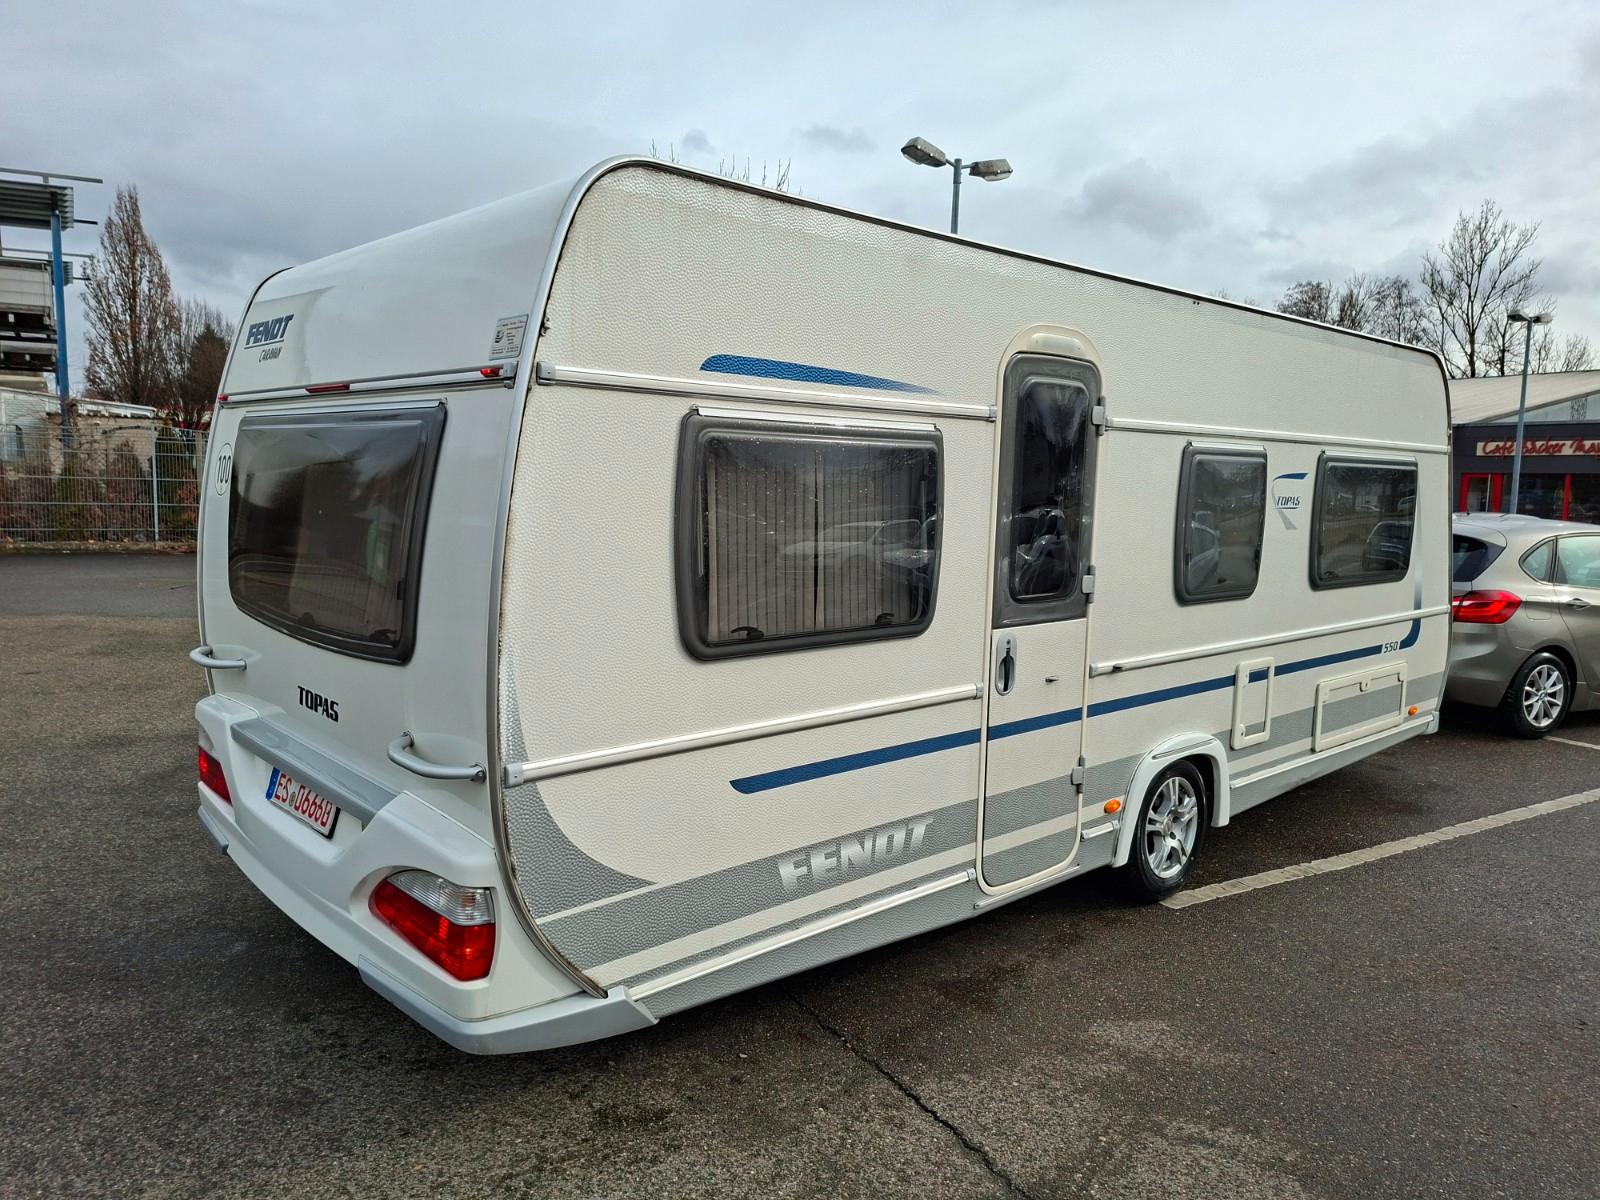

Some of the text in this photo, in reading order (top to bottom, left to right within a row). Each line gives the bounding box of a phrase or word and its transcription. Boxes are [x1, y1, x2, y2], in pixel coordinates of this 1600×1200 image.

[246, 314, 294, 345] FENDT
[216, 455, 231, 484] 100
[1276, 496, 1301, 506] TOPAS
[1383, 641, 1399, 654] 550
[298, 685, 339, 723] TOPAS
[275, 774, 292, 803] ES
[779, 818, 934, 891] FENDT
